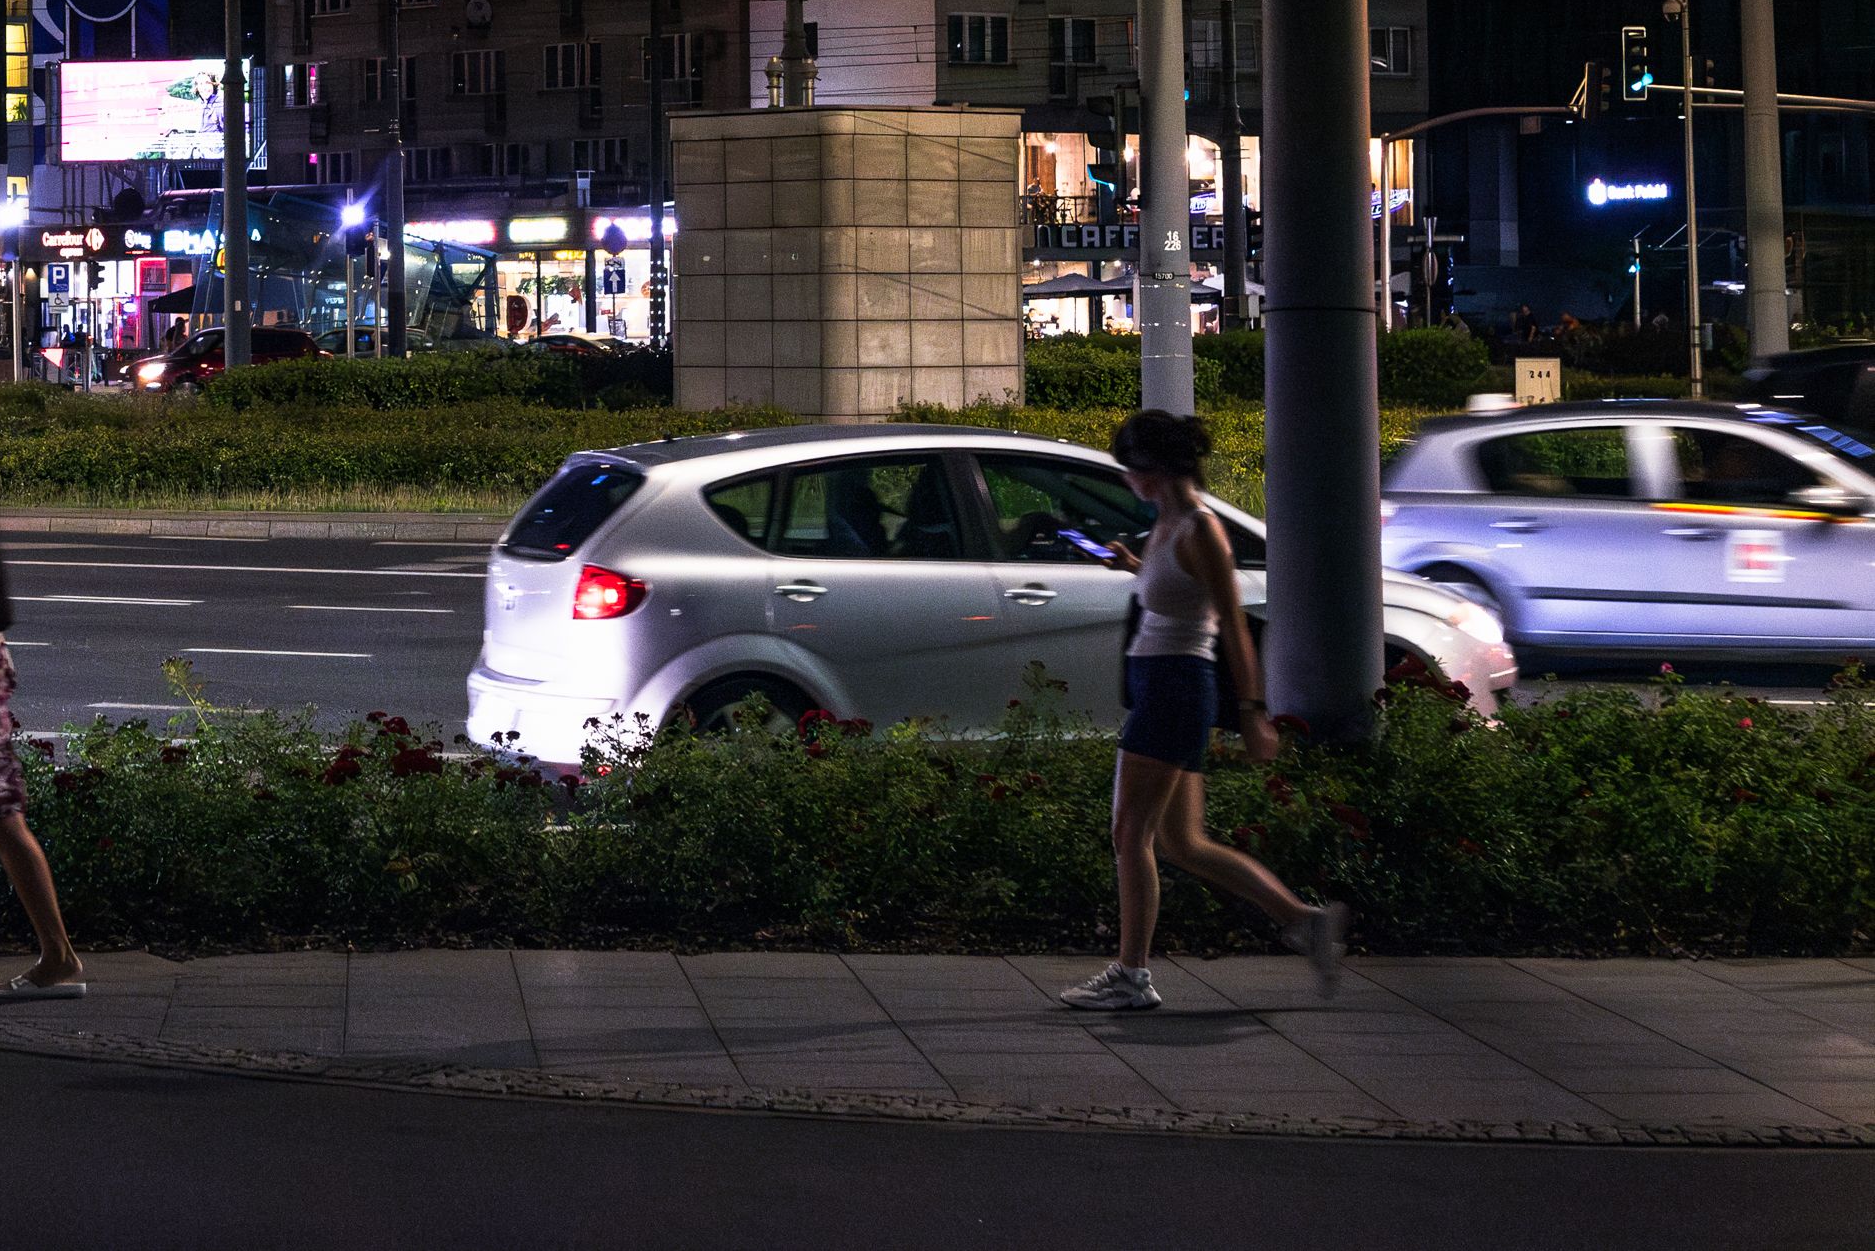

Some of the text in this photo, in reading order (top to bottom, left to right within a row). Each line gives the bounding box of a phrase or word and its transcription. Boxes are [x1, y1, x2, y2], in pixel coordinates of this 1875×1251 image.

[1061, 225, 1140, 248] CAFF
[1166, 230, 1179, 241] 16
[1164, 240, 1182, 251] 226
[52, 266, 66, 285] P
[1528, 370, 1551, 379] 244
